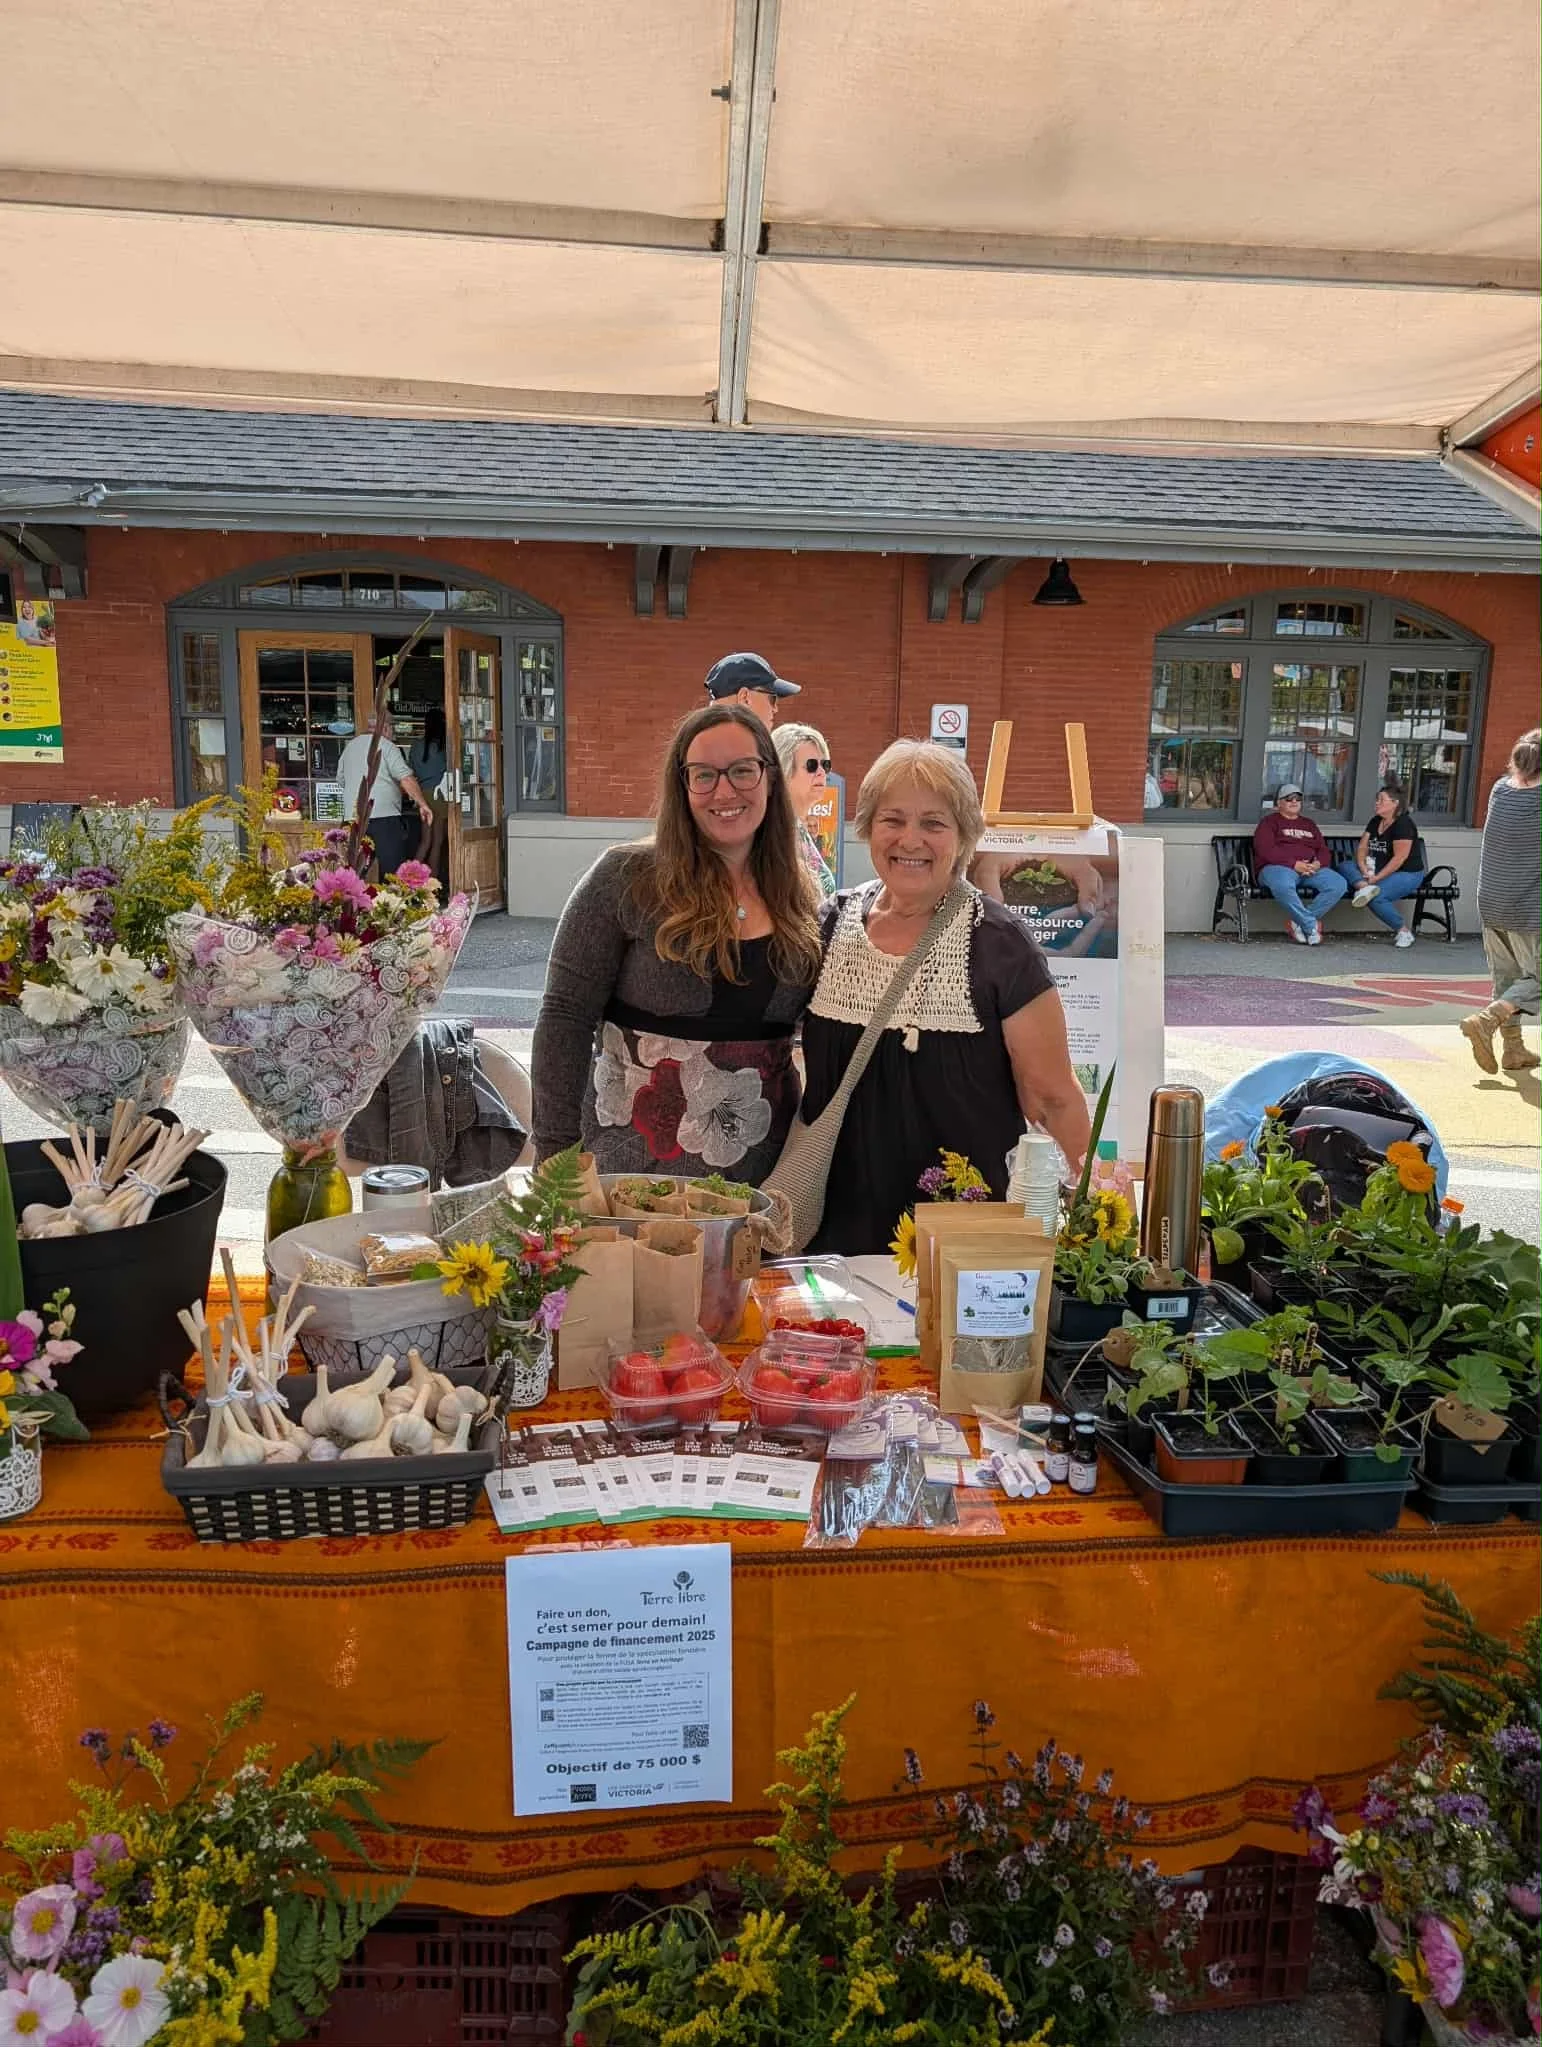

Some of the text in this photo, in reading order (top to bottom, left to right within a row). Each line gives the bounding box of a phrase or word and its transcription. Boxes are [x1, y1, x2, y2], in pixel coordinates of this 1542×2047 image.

[359, 589, 380, 600] 710
[984, 836, 1024, 845] VICTORIA
[640, 1592, 706, 1605] Terre libre
[536, 1607, 611, 1620] Faire un don,
[537, 1613, 706, 1634] c'est semer pour demain!
[526, 1630, 716, 1652] Campagne de financement 2025
[546, 1754, 702, 1775] Objectif de 75 000 $
[608, 1788, 652, 1798] VICTORIA
